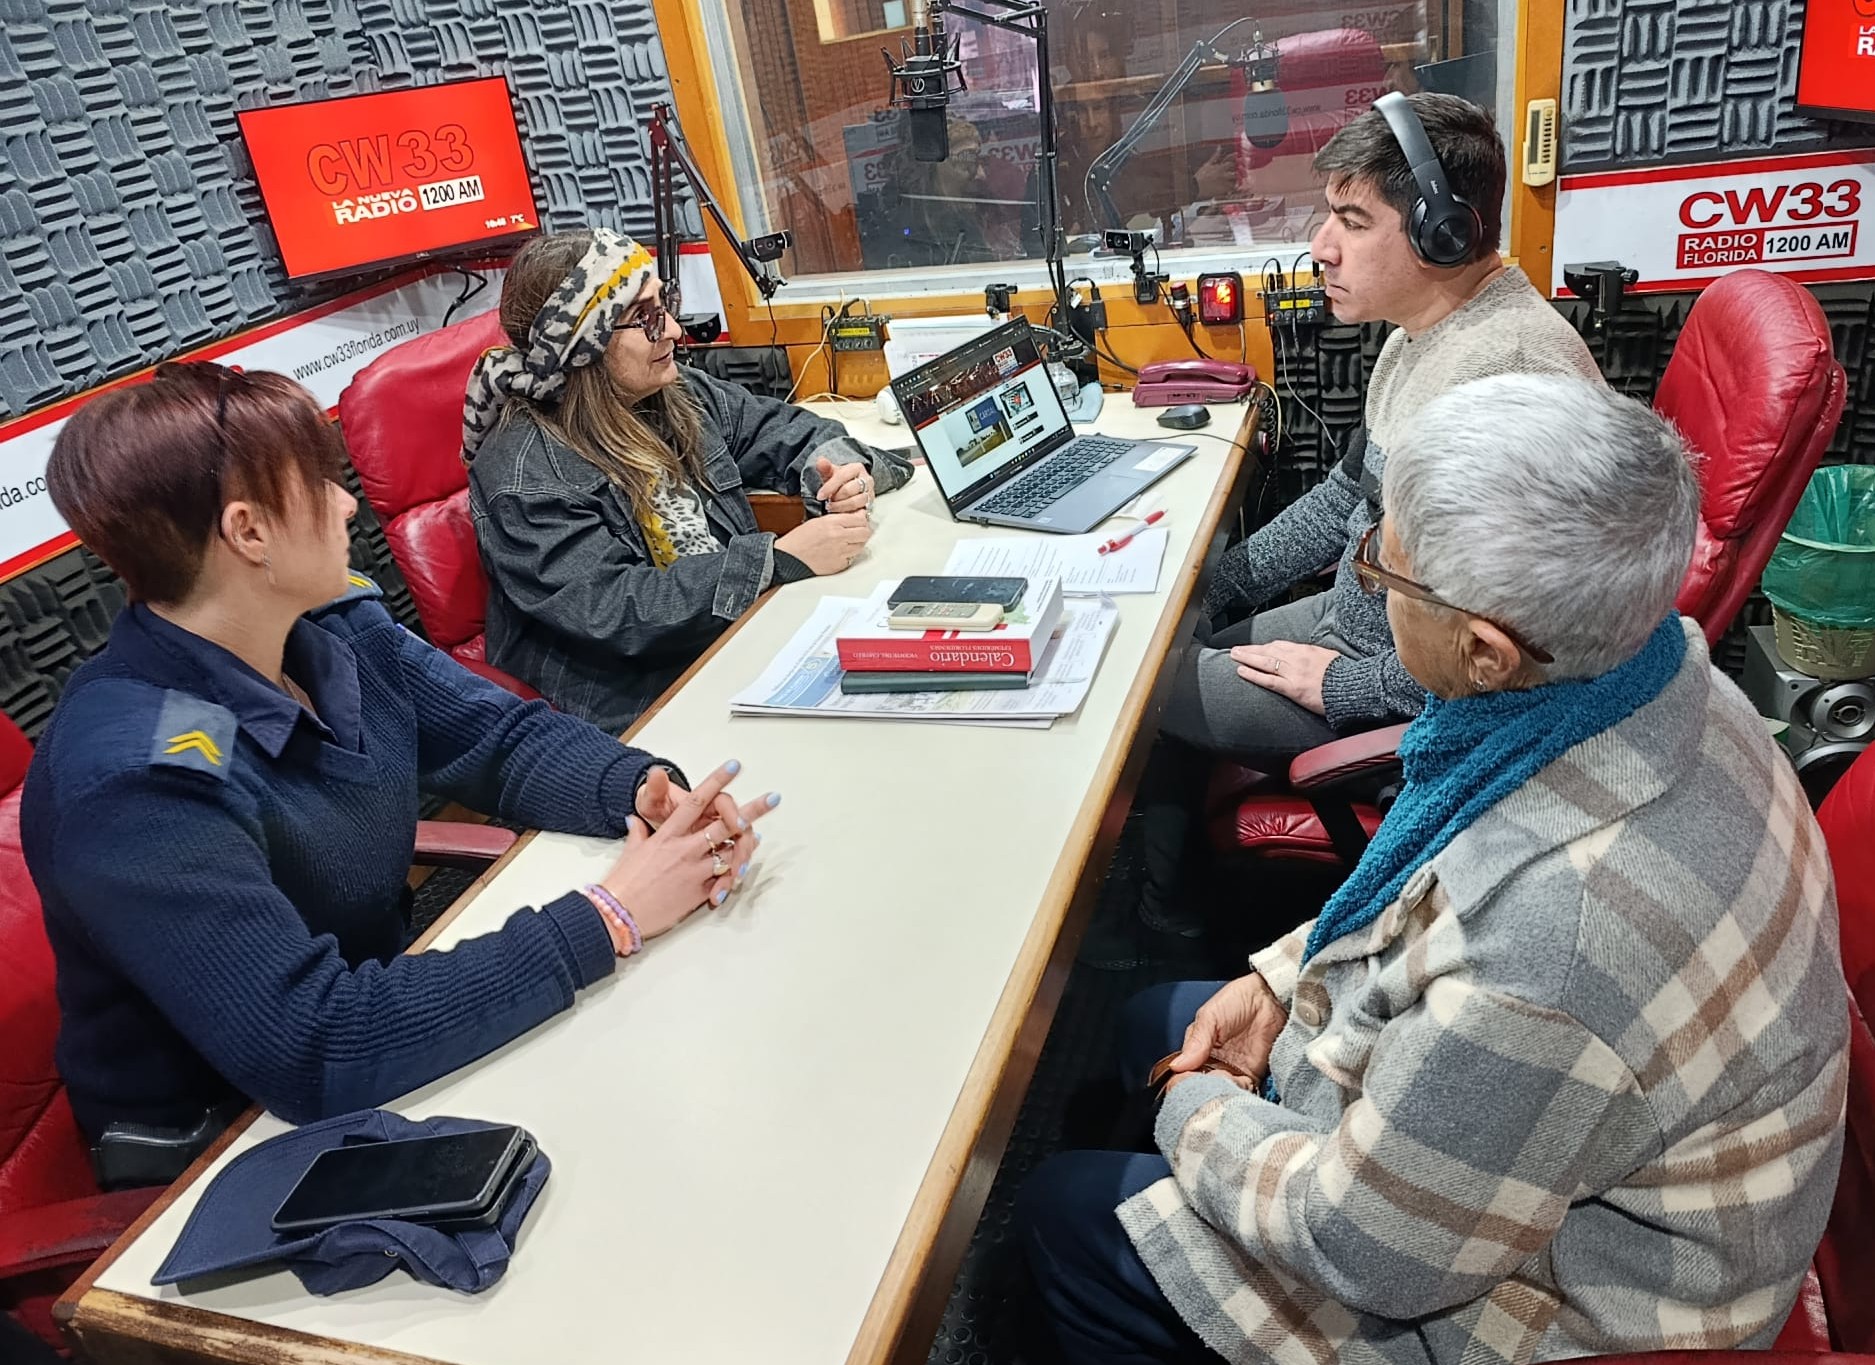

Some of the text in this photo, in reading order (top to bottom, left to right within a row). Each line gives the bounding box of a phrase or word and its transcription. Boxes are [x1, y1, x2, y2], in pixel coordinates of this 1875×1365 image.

[332, 188, 413, 209] LA NUEVA
[423, 179, 480, 205] 1200 AM
[335, 196, 417, 224] RADIO
[1678, 179, 1861, 229] CW33
[1684, 233, 1758, 250] RADIO
[1766, 232, 1849, 253] 1200 AM
[1683, 249, 1758, 265] FLORIDA
[930, 651, 1015, 667] Calendario
